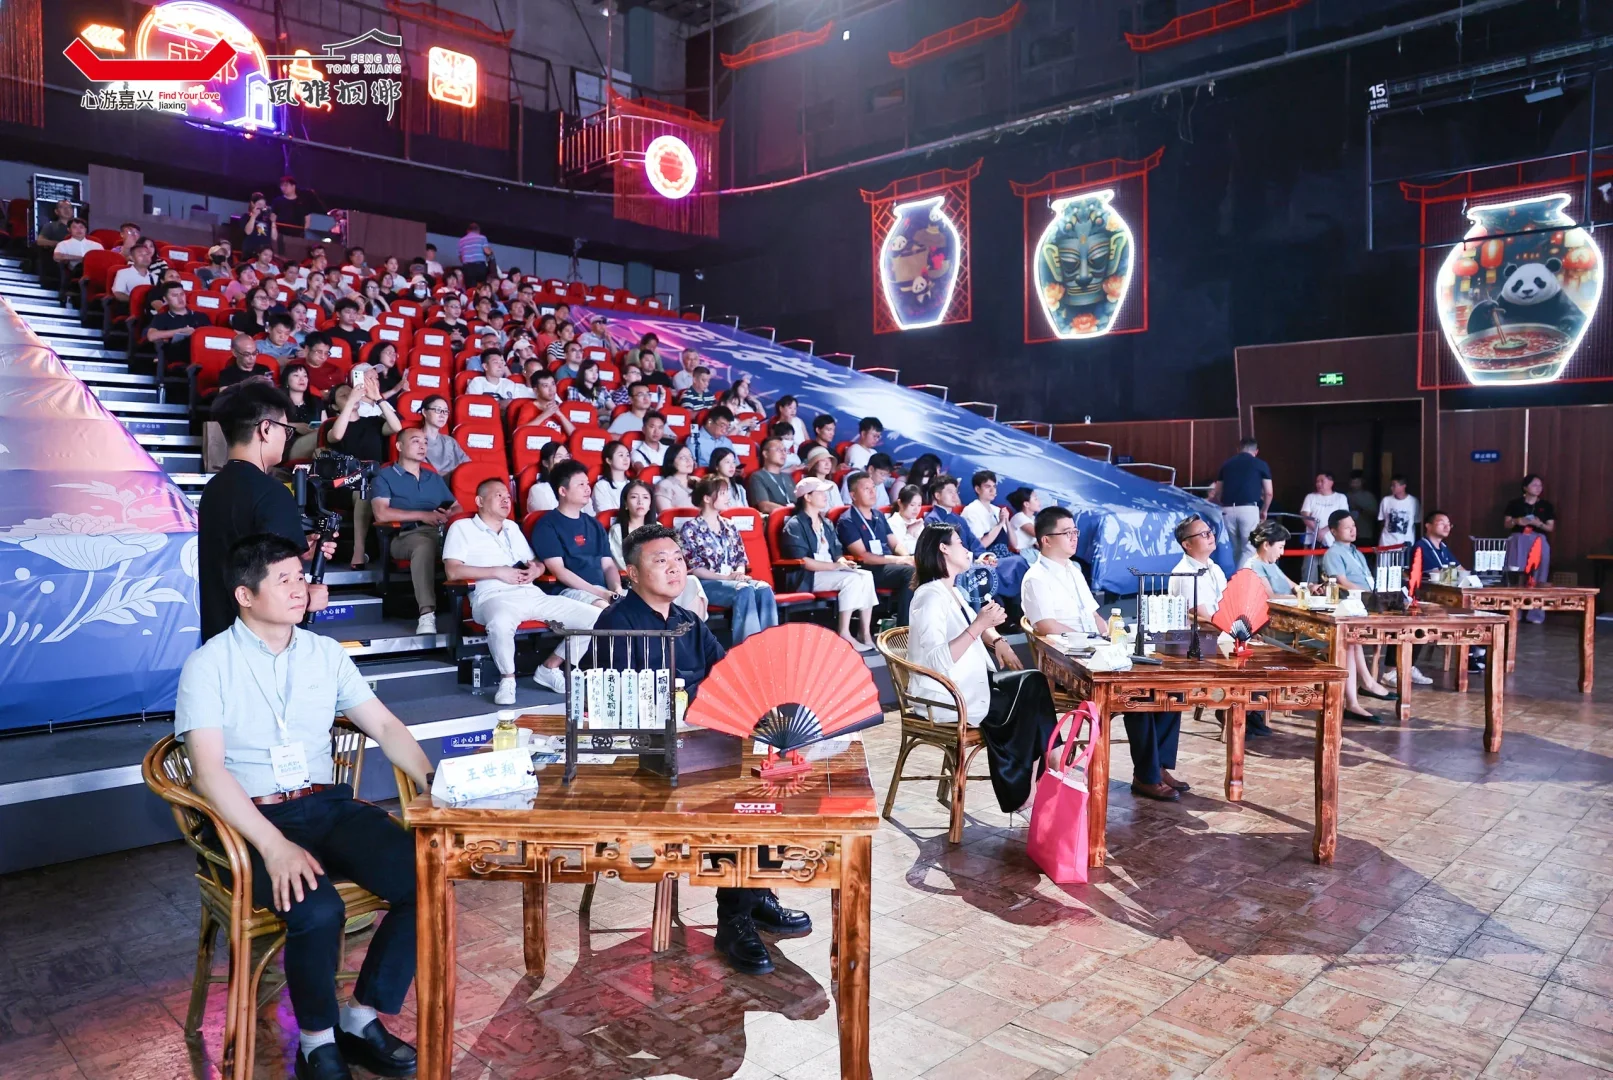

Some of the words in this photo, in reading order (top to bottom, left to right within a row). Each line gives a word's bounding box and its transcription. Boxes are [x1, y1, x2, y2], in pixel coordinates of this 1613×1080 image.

[1368, 83, 1386, 99] 15
[460, 733, 488, 745] 小心台阶
